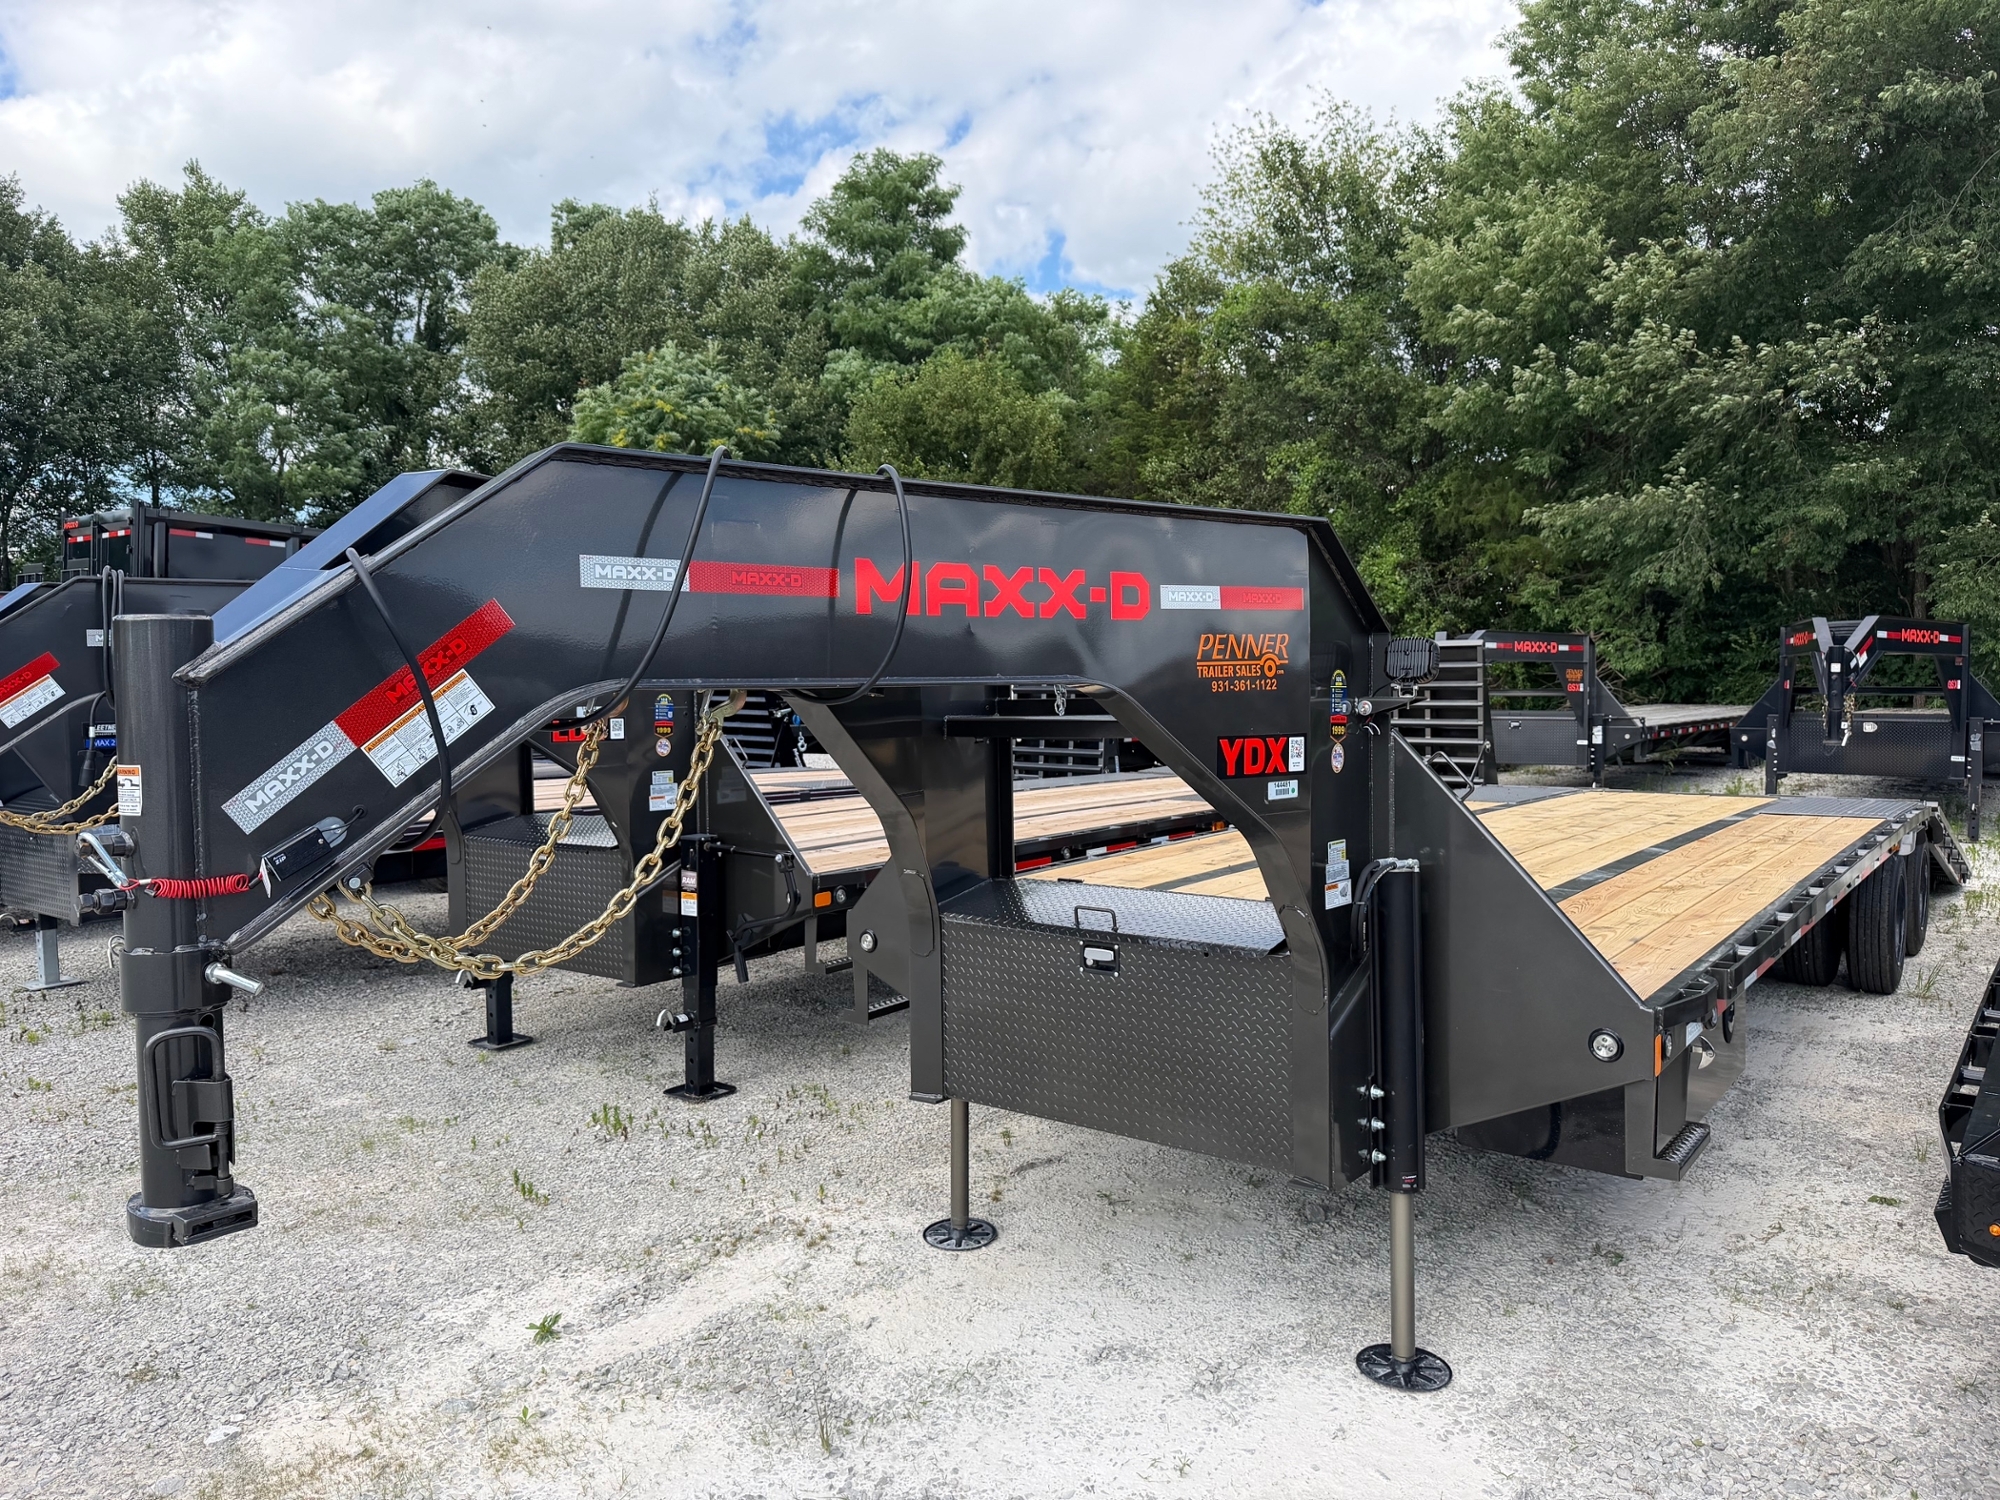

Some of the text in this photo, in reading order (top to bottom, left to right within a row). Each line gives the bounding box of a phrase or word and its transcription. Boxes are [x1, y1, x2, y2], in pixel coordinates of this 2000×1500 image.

[594, 564, 676, 582] MAXX-D
[731, 571, 802, 587] MAXX-D
[855, 558, 1150, 621] MAXX-D
[1168, 591, 1213, 602] MAXX-D
[1242, 592, 1283, 604] MAXX-D
[1901, 628, 1940, 644] MAXX-D
[1196, 633, 1289, 660] PENNER
[1514, 641, 1558, 653] MAXX-D
[1197, 664, 1261, 678] TRAILER SALES
[0, 671, 33, 697] AXX-D
[1211, 679, 1278, 692] 931-361-1122
[1331, 725, 1345, 735] 1999
[1219, 736, 1287, 776] YDX
[243, 740, 334, 814] MAXX-D
